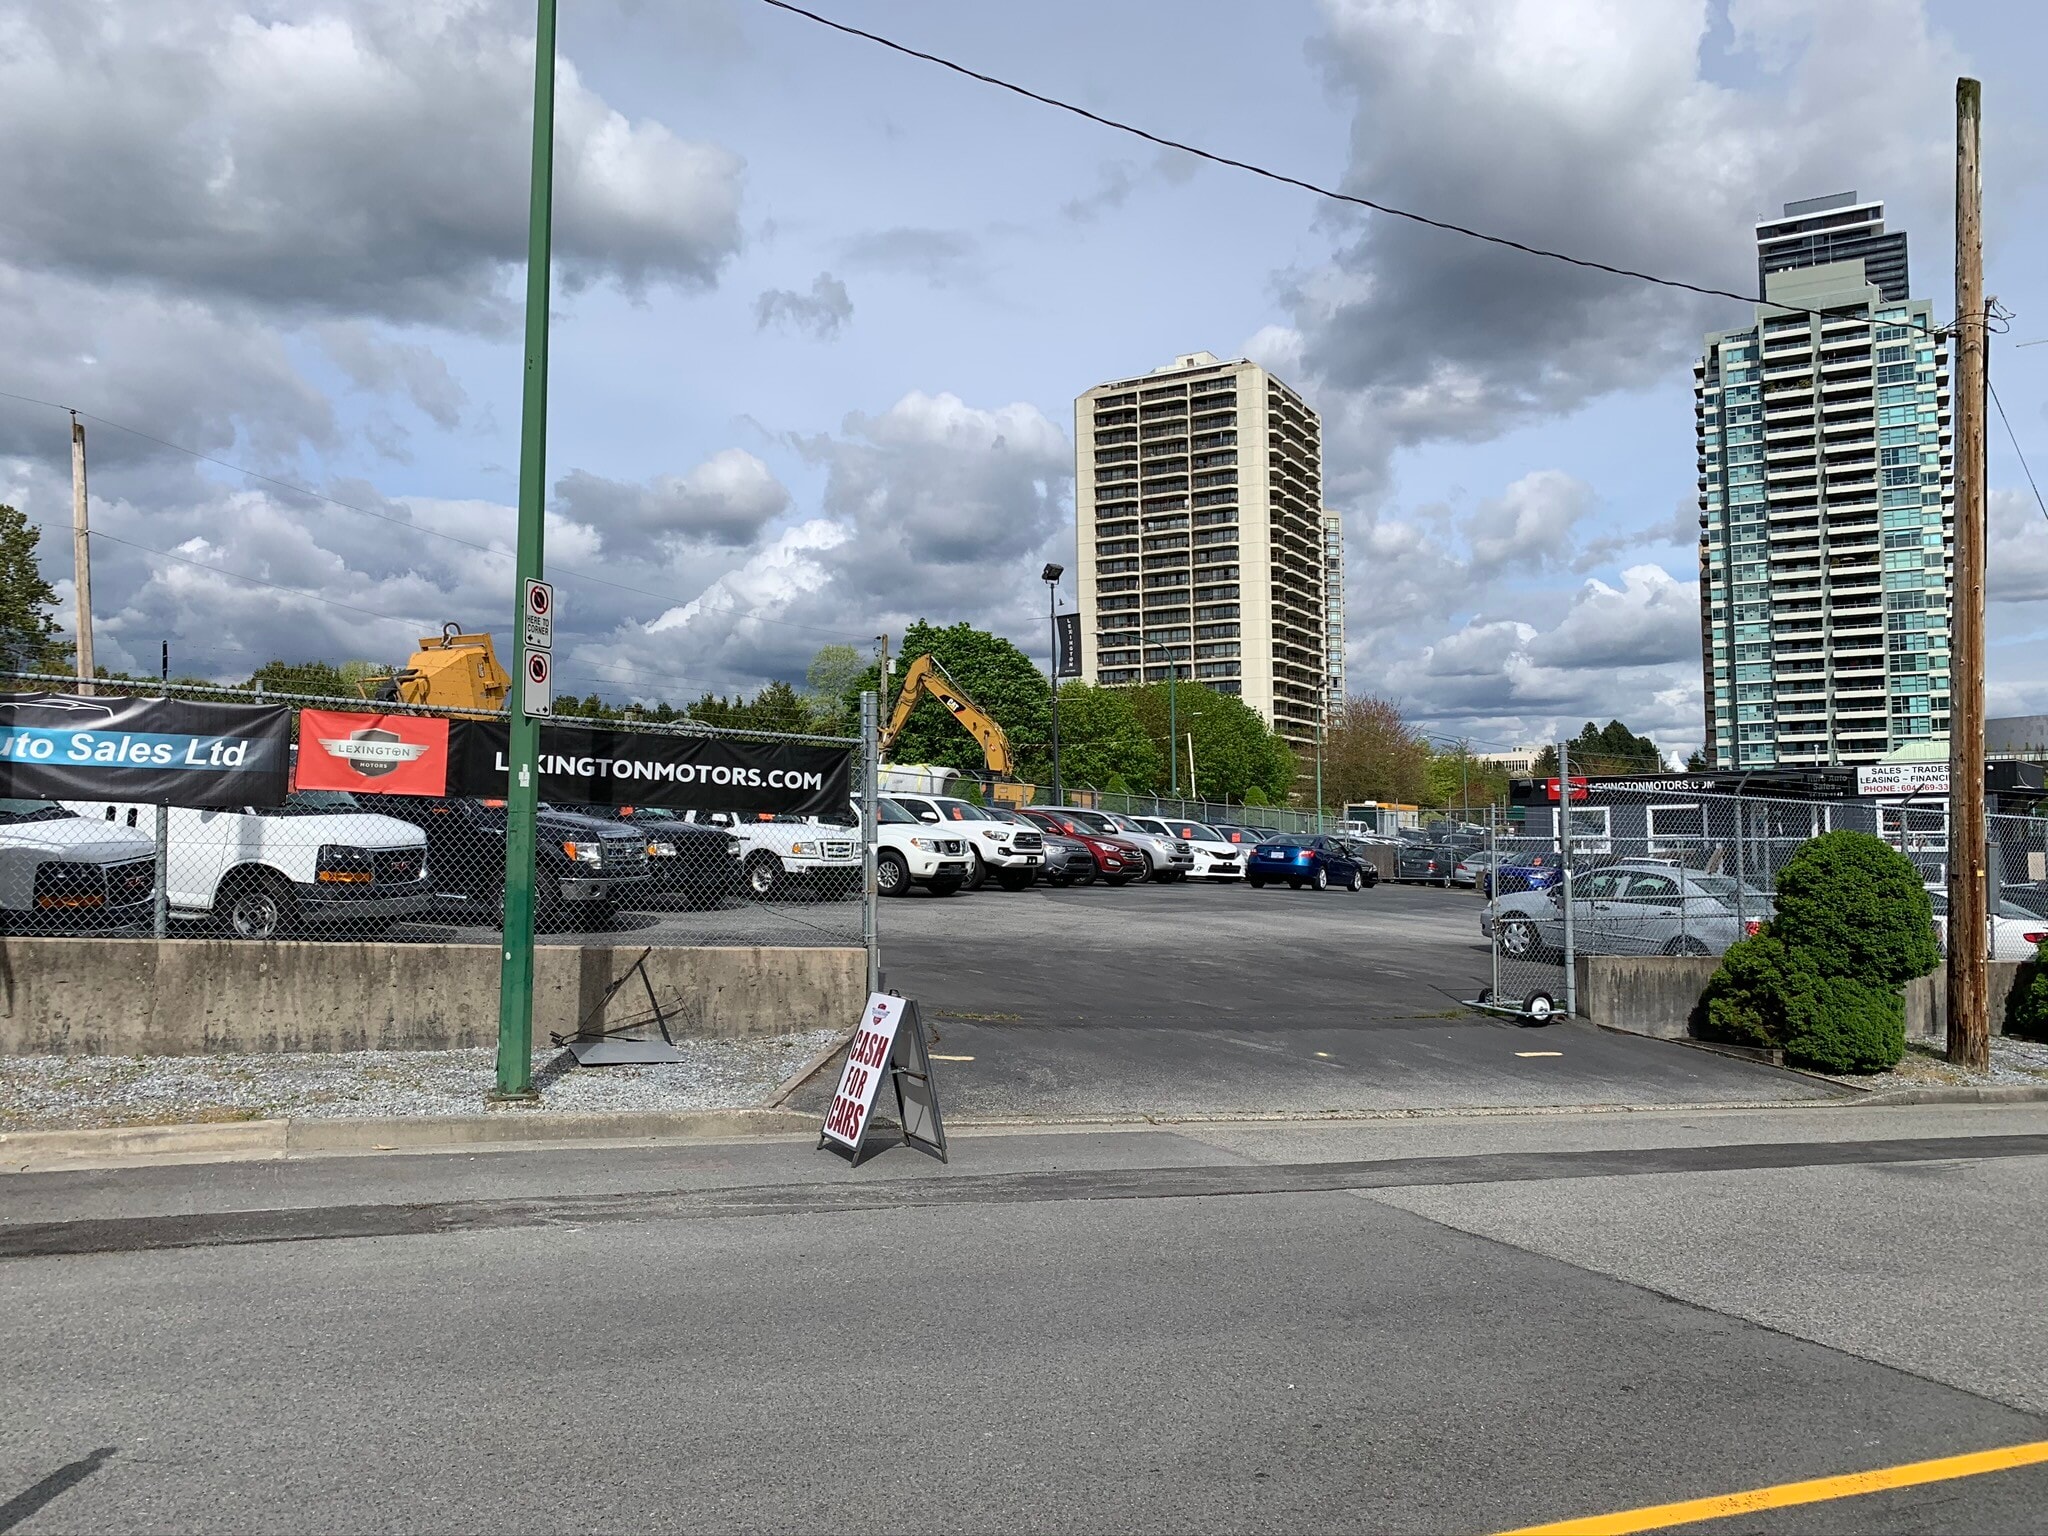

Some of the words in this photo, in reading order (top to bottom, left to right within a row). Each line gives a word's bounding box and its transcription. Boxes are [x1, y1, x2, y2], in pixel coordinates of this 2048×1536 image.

[527, 615, 541, 625] HERE
[543, 618, 550, 627] TO
[528, 623, 549, 635] CORNER
[946, 698, 960, 712] CAT
[67, 733, 173, 764] Sales
[184, 738, 248, 767] Ltd
[338, 744, 410, 757] LEXINGTON
[495, 751, 822, 791] LINGTONMOTORS.COM
[1871, 767, 1902, 775] SALES
[1911, 765, 1950, 773] TRADES
[1860, 776, 1900, 784] LEASING
[850, 1029, 889, 1069] CASH
[843, 1066, 868, 1099] FOR
[827, 1095, 864, 1140] CARS
